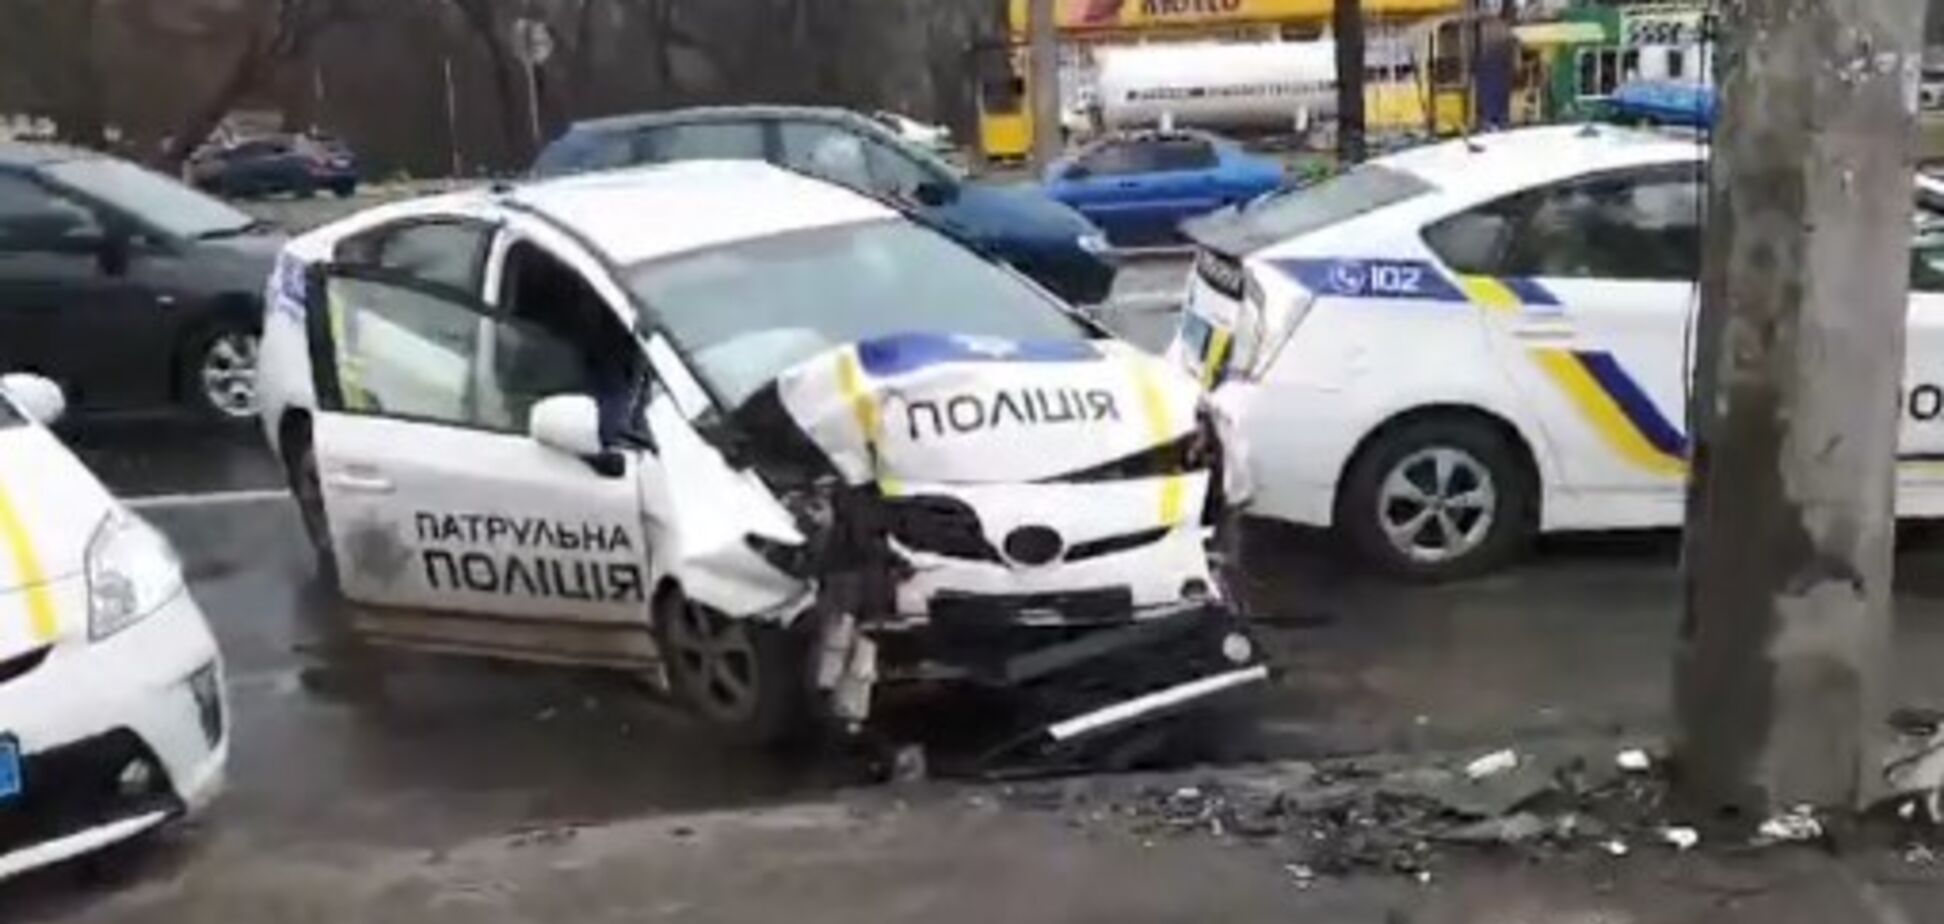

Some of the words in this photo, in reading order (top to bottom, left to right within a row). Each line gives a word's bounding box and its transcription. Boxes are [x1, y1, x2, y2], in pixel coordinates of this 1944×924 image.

[1371, 266, 1421, 291] 102
[907, 388, 1119, 440] ПОЛІЦІЯ
[415, 511, 632, 551] ПАТРУЛЬНА
[423, 549, 645, 602] ПОЛІЦІЯ
